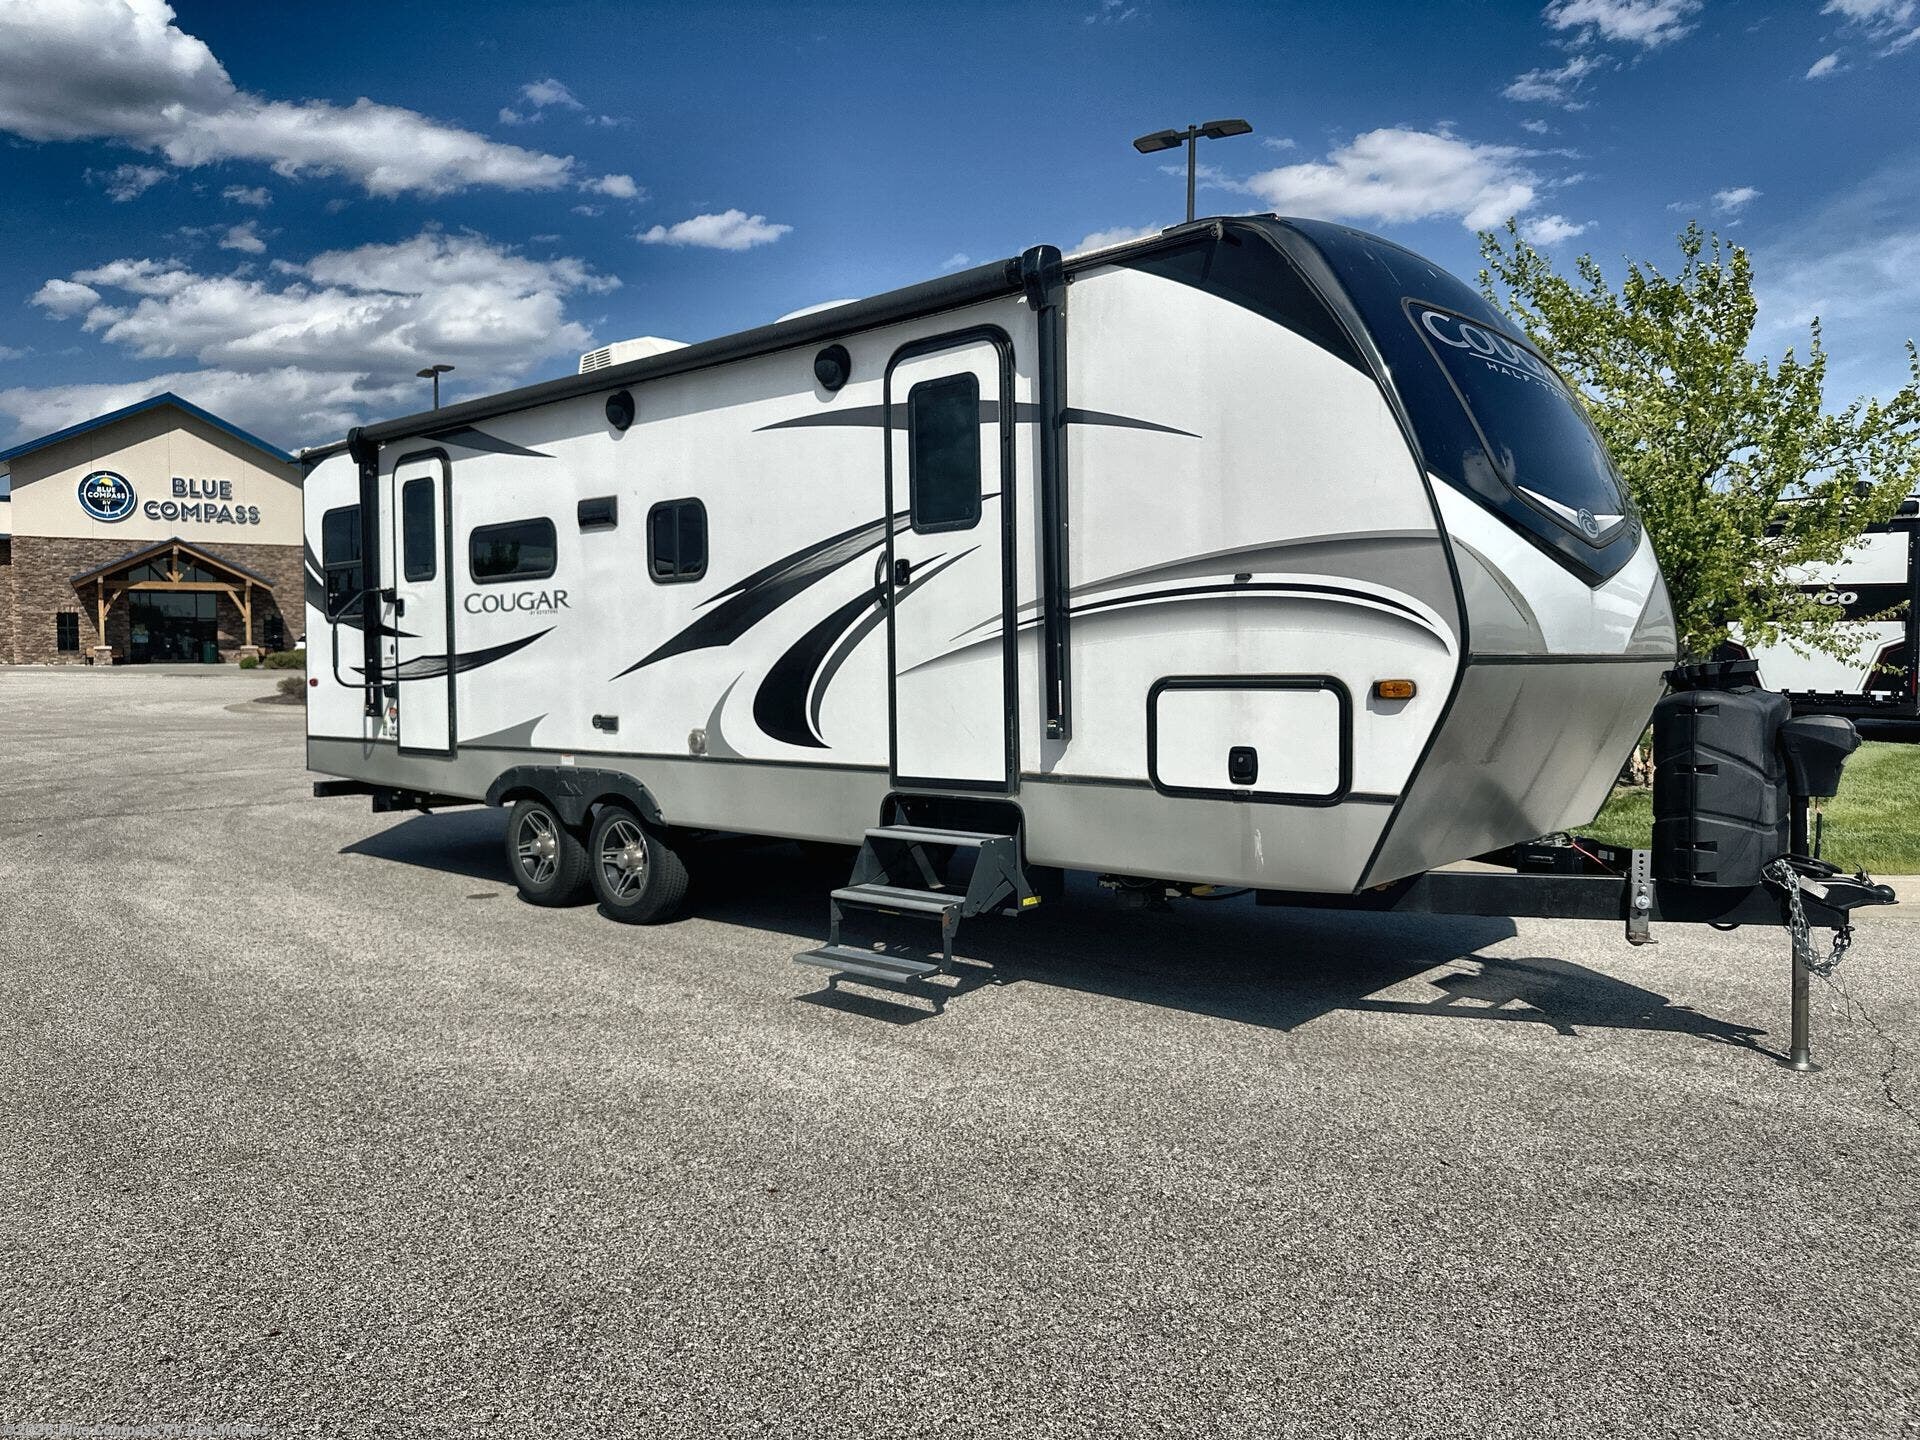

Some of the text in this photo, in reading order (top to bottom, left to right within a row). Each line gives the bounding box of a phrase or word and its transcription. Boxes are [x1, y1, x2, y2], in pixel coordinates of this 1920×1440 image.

[1421, 311, 1566, 391] COUG
[87, 491, 126, 499] COMPASS
[172, 477, 232, 500] BLUE
[143, 500, 260, 525] COMPASS
[464, 589, 572, 614] COUGAR
